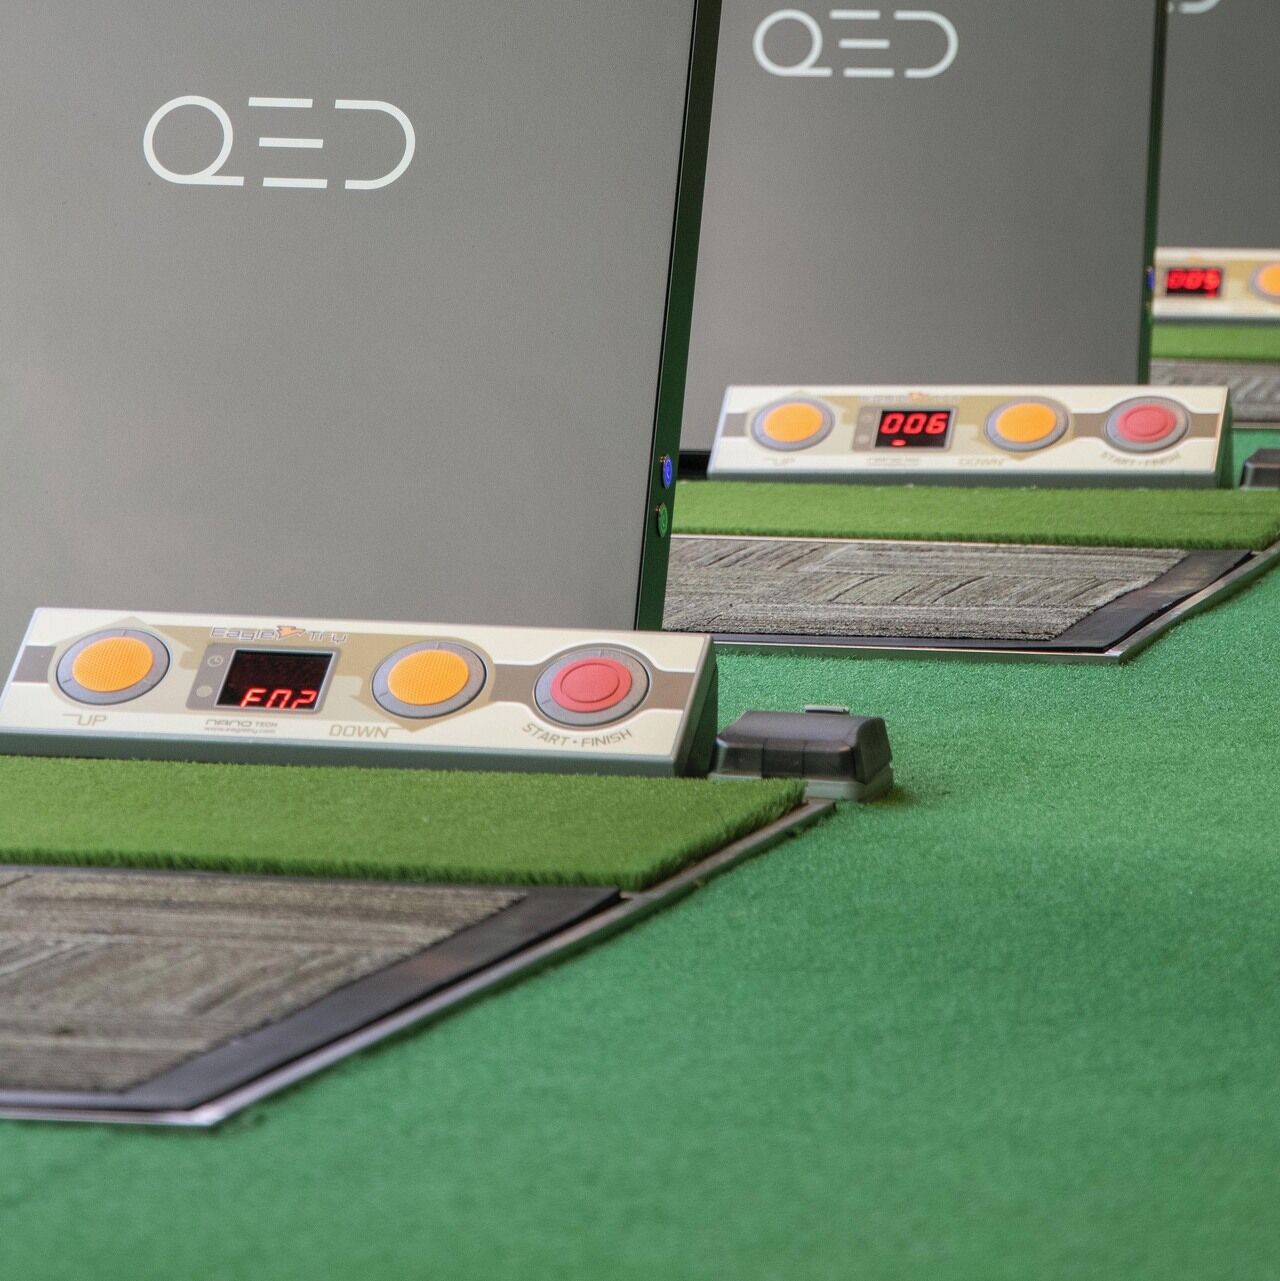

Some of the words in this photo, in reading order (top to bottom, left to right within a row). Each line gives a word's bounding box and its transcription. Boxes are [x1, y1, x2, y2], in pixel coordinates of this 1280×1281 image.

[752, 8, 959, 79] QED
[143, 95, 416, 190] QED
[879, 412, 949, 435] 006
[210, 626, 276, 641] Eagle
[308, 630, 348, 644] Try
[75, 714, 108, 727] UP
[255, 721, 278, 729] TECH
[328, 723, 390, 738] DOWN
[522, 722, 571, 746] START
[580, 728, 633, 748] FINISH
